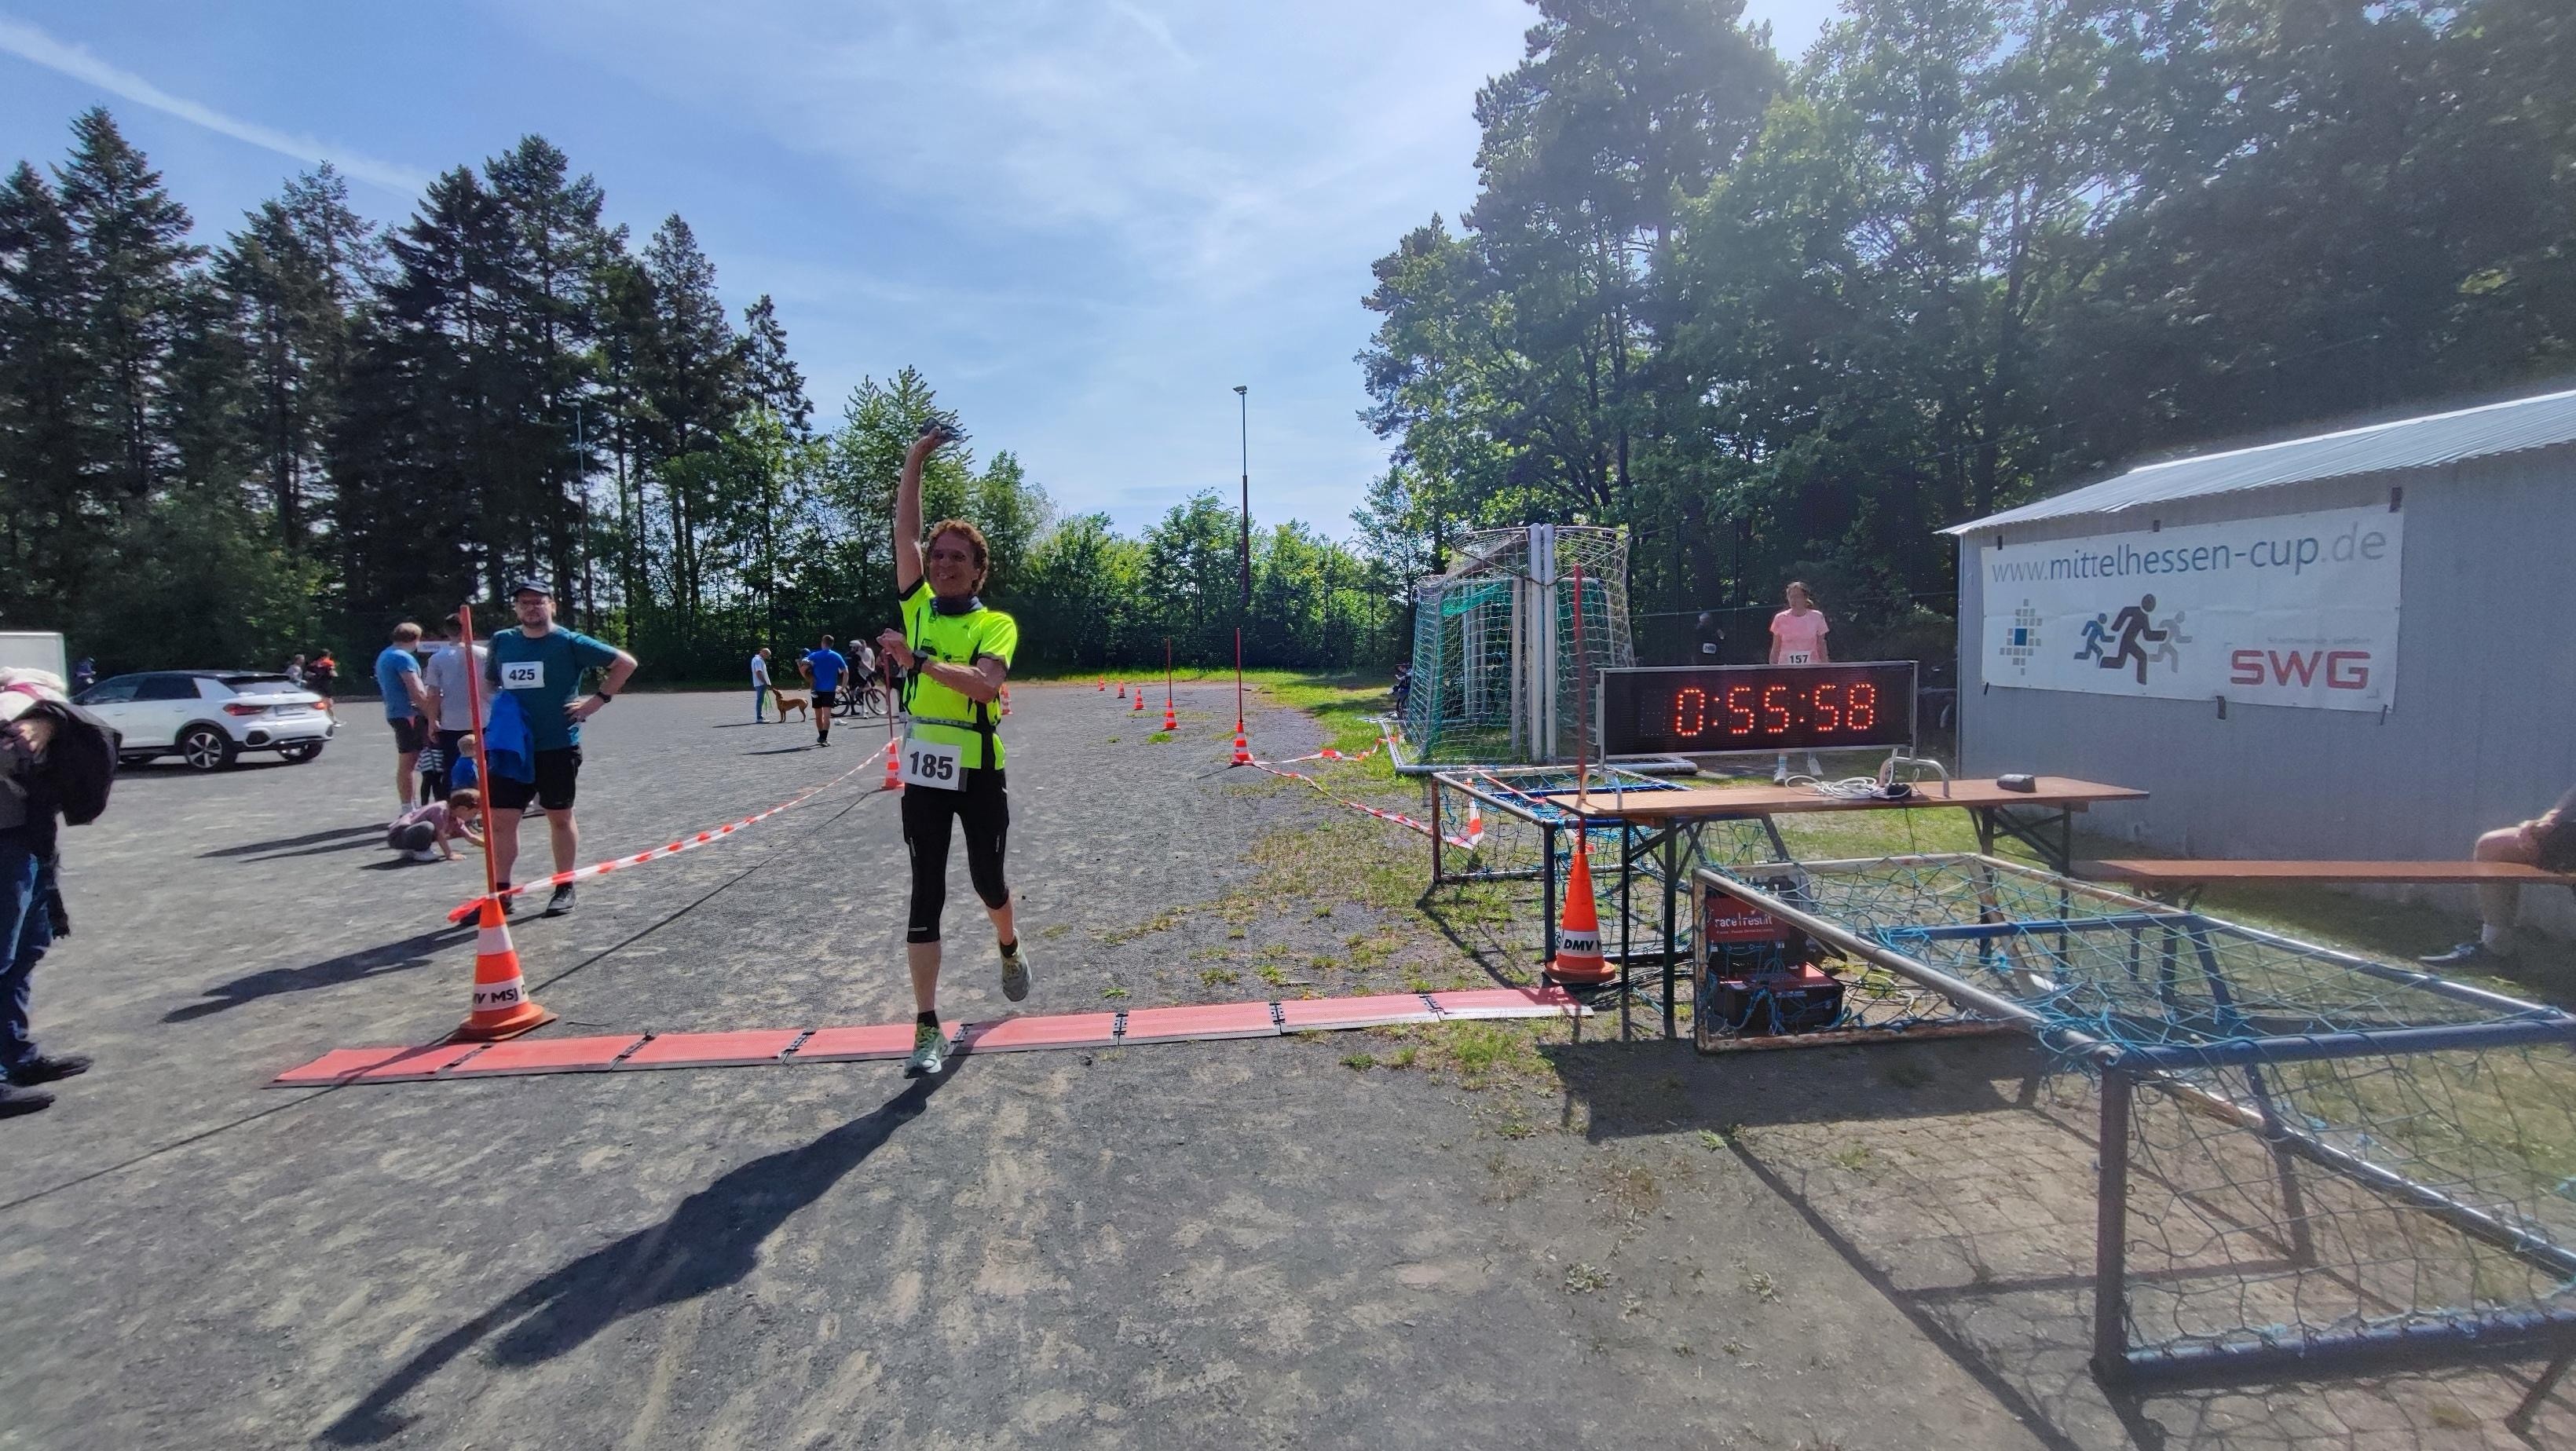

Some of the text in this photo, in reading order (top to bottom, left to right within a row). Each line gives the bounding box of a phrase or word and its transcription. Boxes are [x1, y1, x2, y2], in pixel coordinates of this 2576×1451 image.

[1992, 521, 2386, 582] www.mittelhessen-cup.de
[1789, 654, 1809, 664] 157
[2230, 650, 2370, 689] SWG
[509, 669, 535, 681] 425
[1676, 684, 1876, 736] 0:55:58
[909, 751, 953, 780] 185
[1564, 938, 1594, 951] DMV
[491, 988, 518, 1003] MSJ
